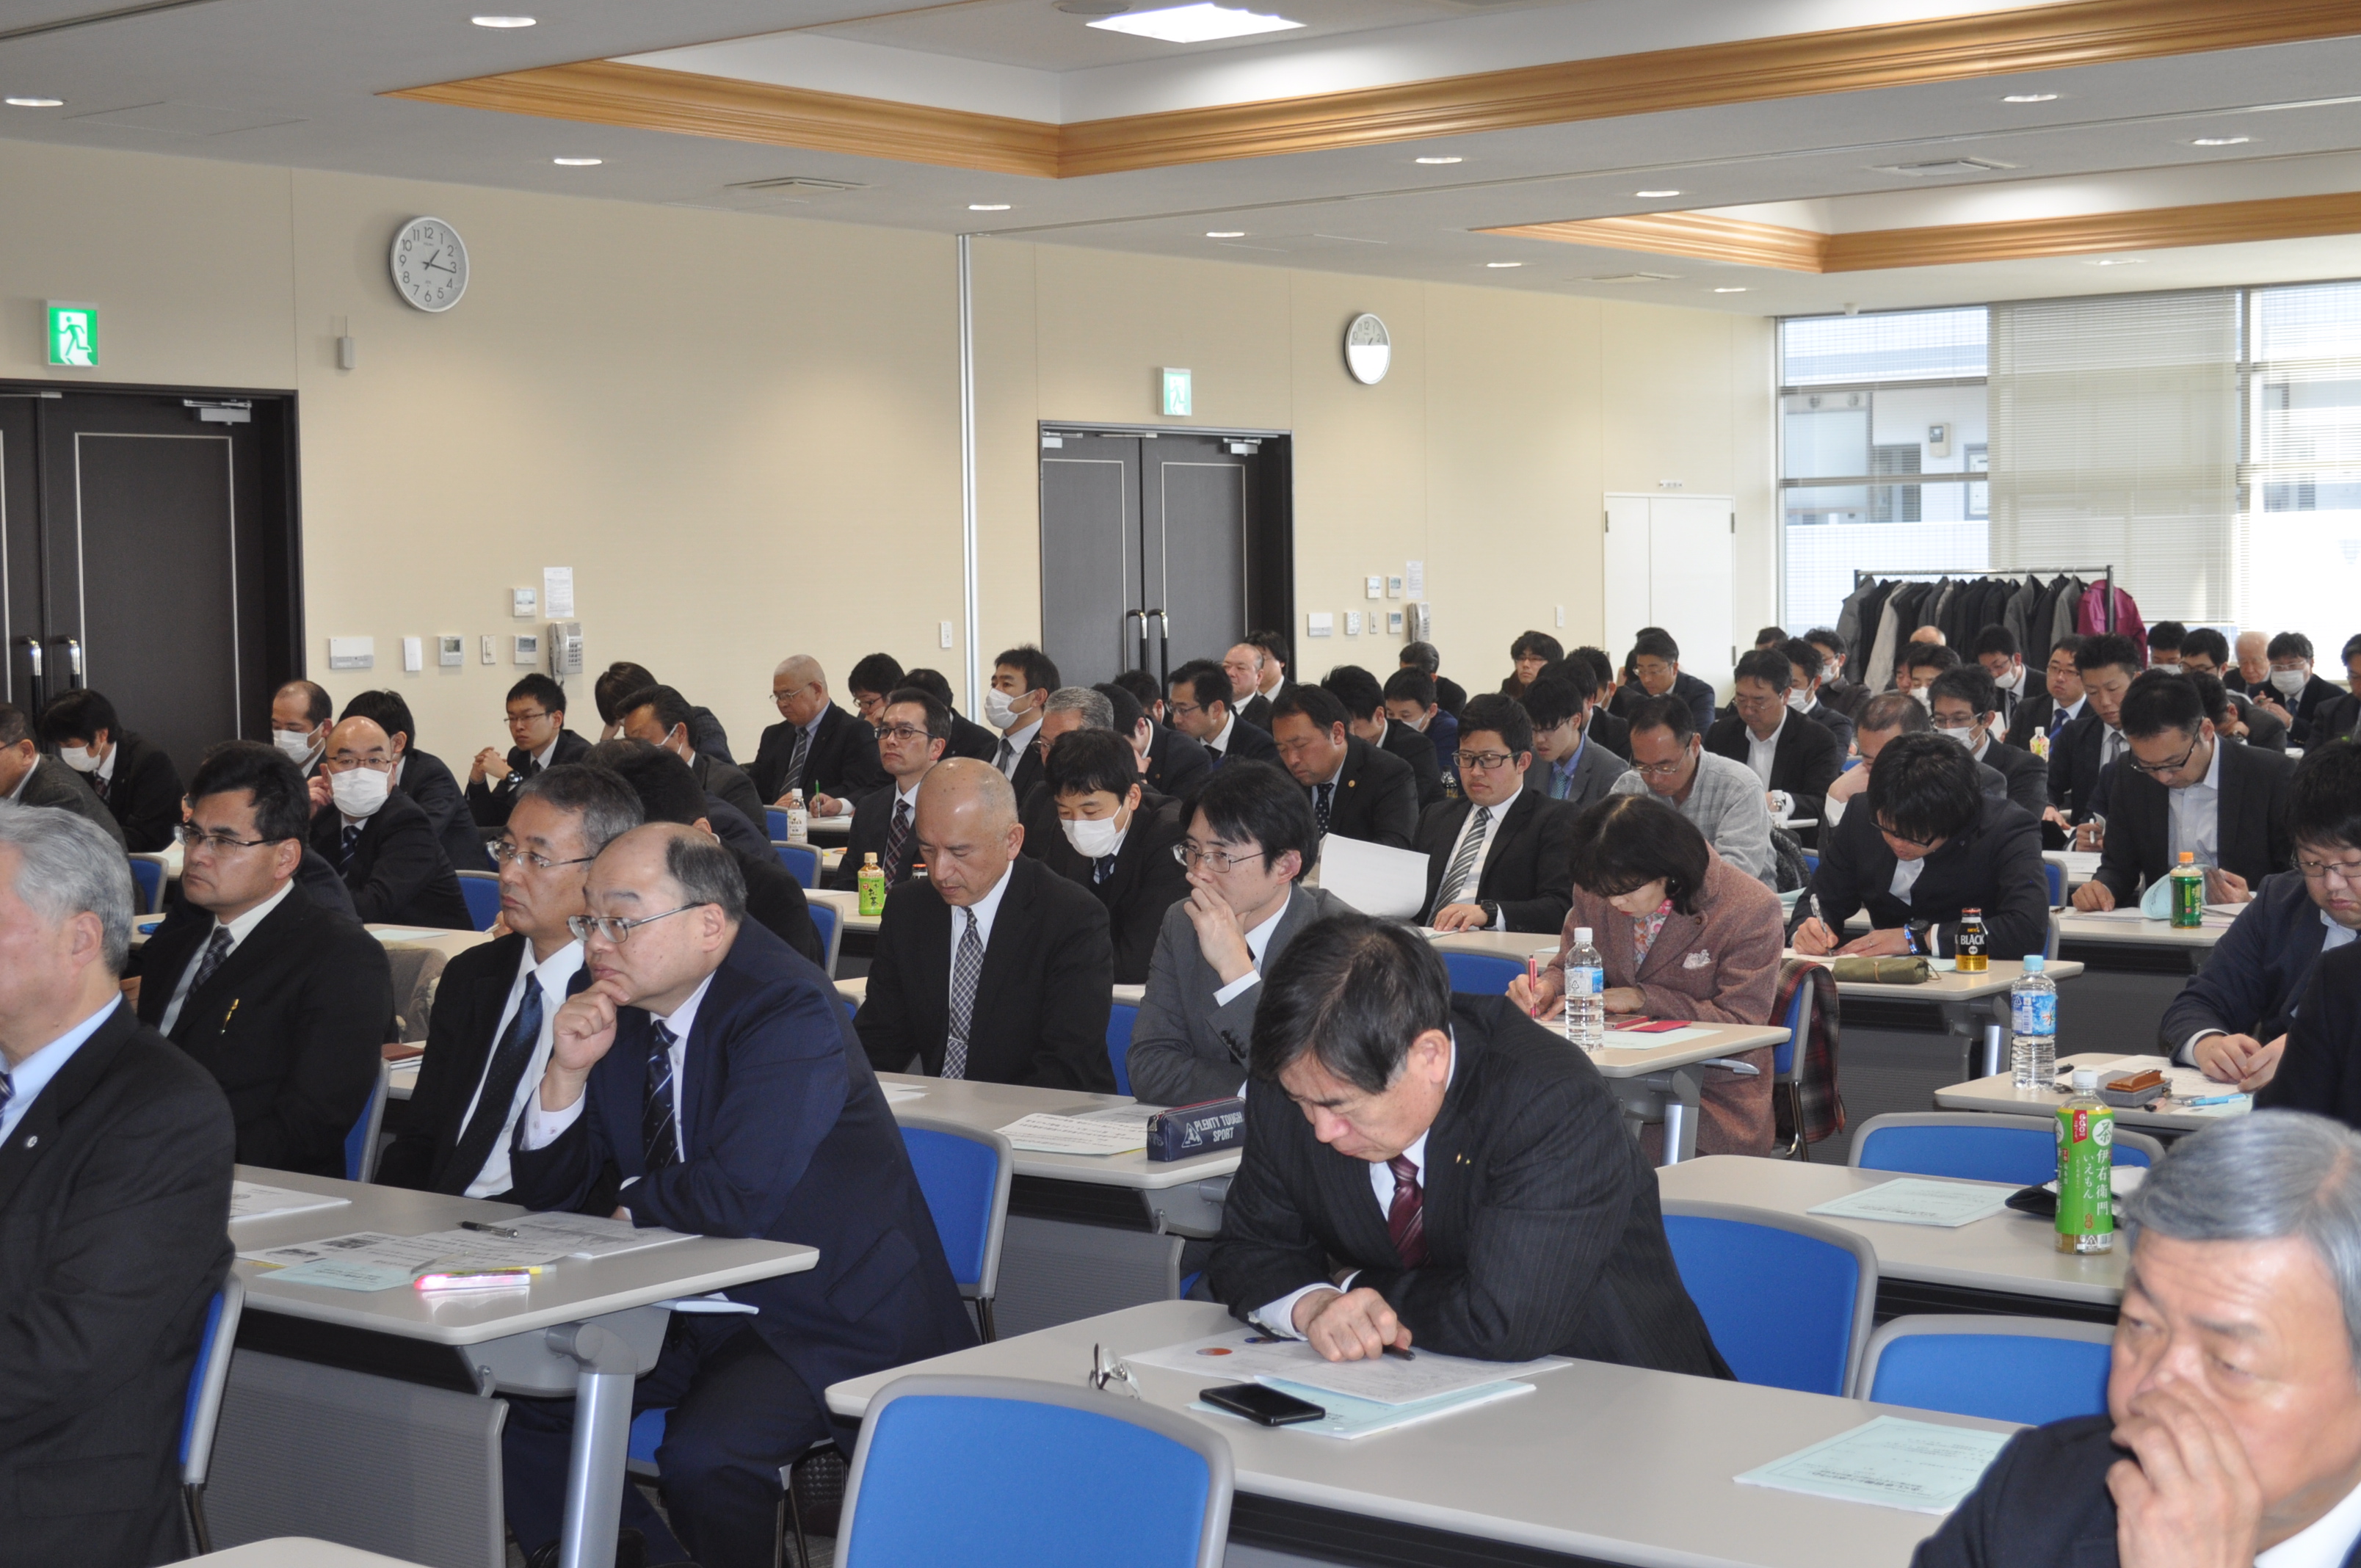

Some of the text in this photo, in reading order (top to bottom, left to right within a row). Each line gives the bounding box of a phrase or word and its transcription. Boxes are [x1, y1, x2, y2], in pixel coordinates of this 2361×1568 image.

[413, 229, 420, 242] 11
[424, 226, 434, 239] 12
[402, 239, 413, 252] 10
[447, 244, 454, 257] 2
[399, 255, 407, 266] 9
[451, 261, 457, 274] 3
[402, 271, 410, 284] 8
[446, 277, 453, 288] 4
[413, 284, 420, 296] 7
[424, 290, 432, 302] 6
[437, 287, 444, 300] 5
[1960, 934, 1984, 945] BLACK
[1193, 1111, 1243, 1132] PLENTY TOUGH
[1212, 1127, 1234, 1142] SPORT
[2095, 1121, 2112, 1144] 茶
[2083, 1155, 2094, 1199] いえもん
[2096, 1148, 2109, 1216] 伊右衛門
